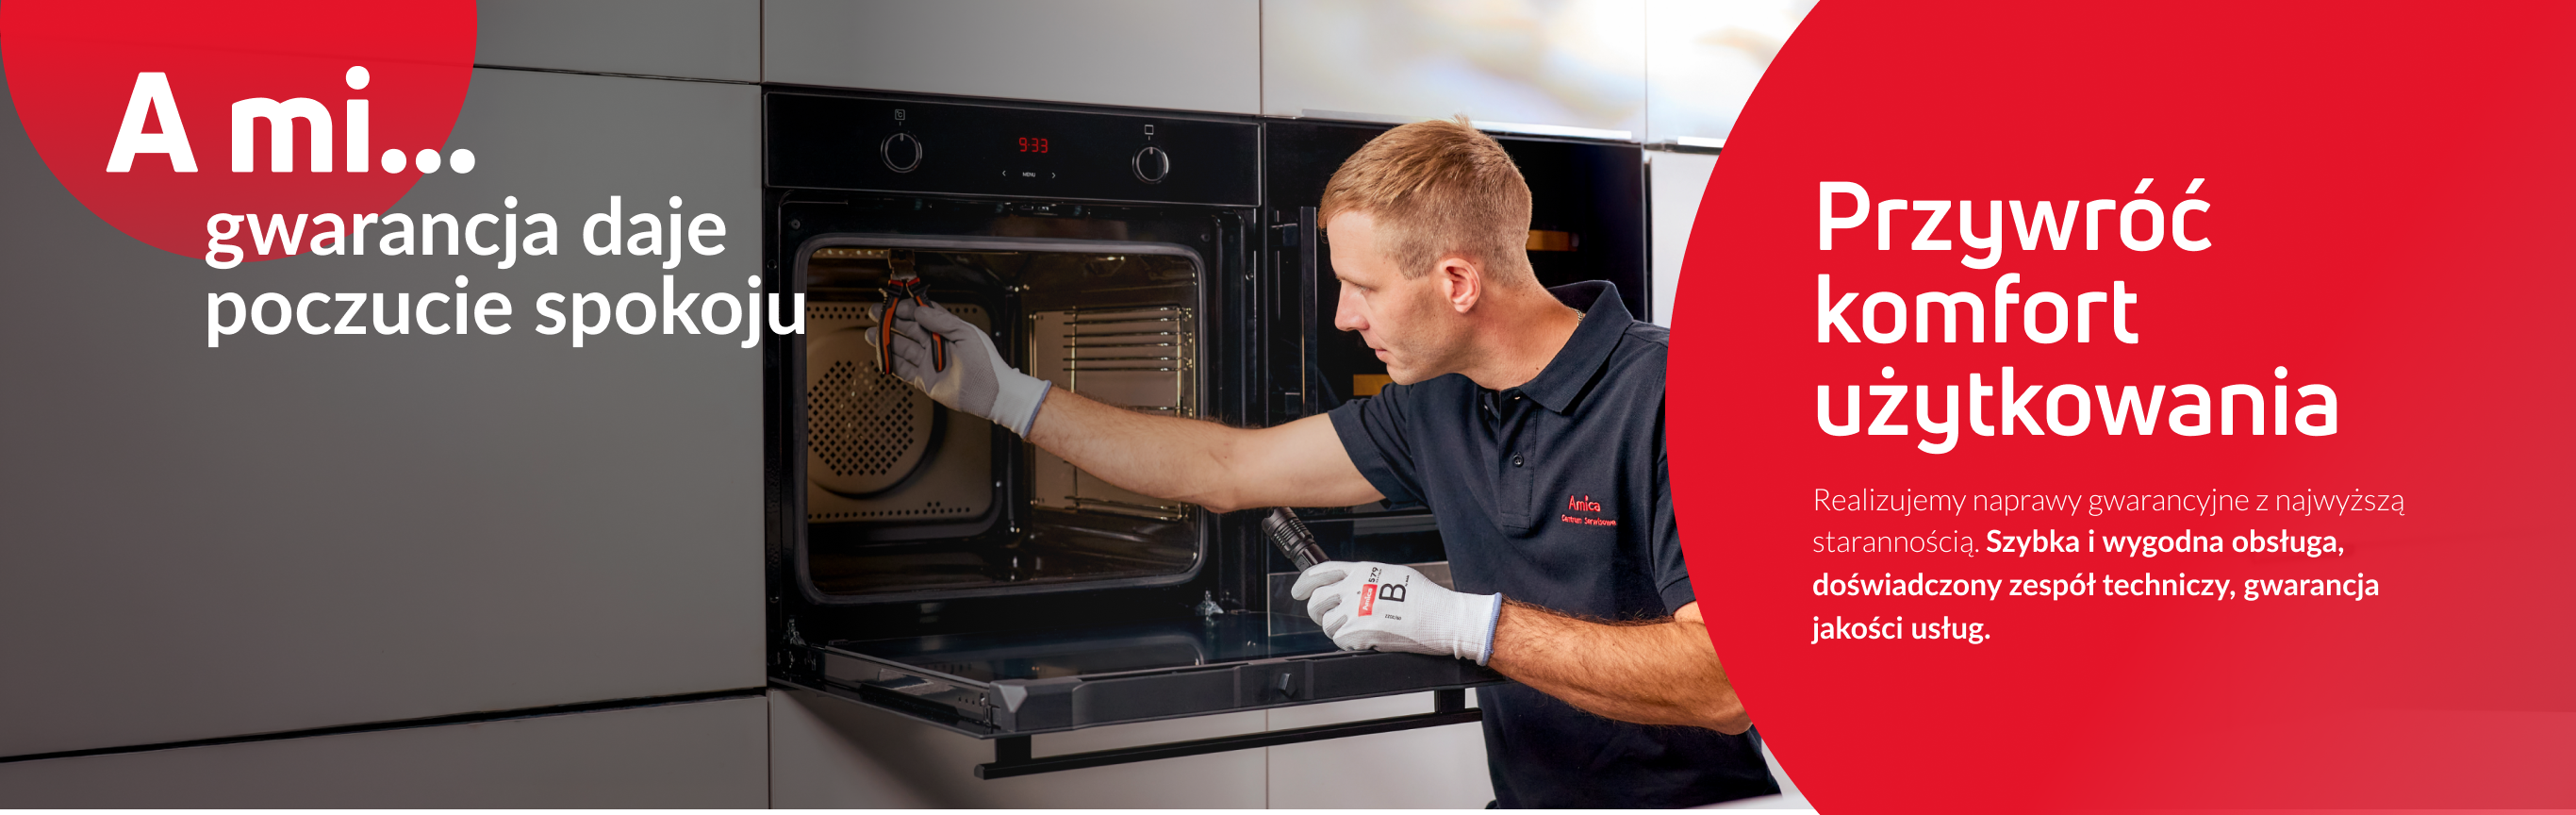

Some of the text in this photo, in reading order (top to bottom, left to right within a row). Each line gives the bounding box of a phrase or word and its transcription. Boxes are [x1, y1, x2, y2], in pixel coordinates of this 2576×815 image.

[1568, 494, 1601, 512] Amica
[1561, 514, 1582, 524] Centrum
[1362, 567, 1379, 610] Amica 579
[1379, 583, 1406, 602] B
